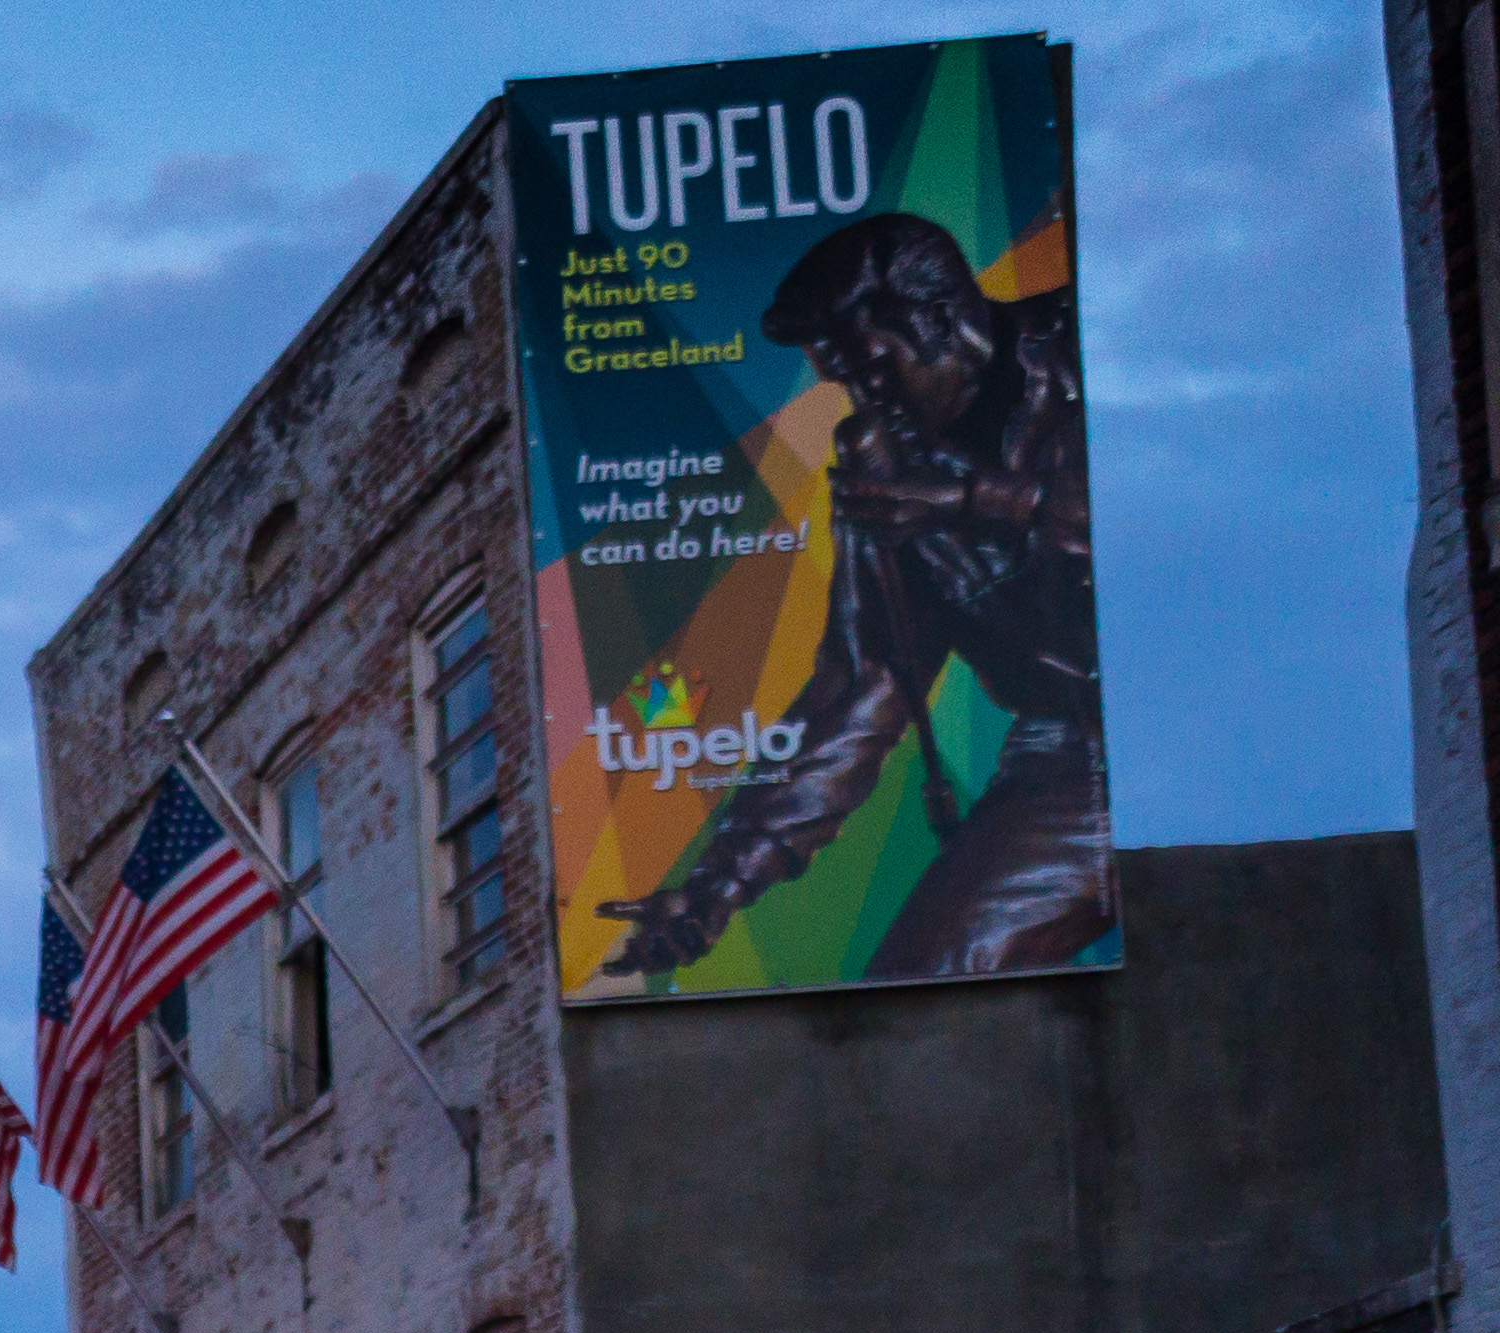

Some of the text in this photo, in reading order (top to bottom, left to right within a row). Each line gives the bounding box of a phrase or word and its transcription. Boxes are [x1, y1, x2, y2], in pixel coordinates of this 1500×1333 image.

[550, 96, 872, 236] TUPELO
[560, 241, 689, 279] Just 90
[561, 276, 695, 310] Minutes
[563, 311, 645, 343] from
[563, 336, 745, 374] Graceland
[576, 451, 725, 489] Imagine
[578, 489, 744, 529] what you
[580, 523, 810, 567] can do here!
[584, 707, 808, 791] tupelo
